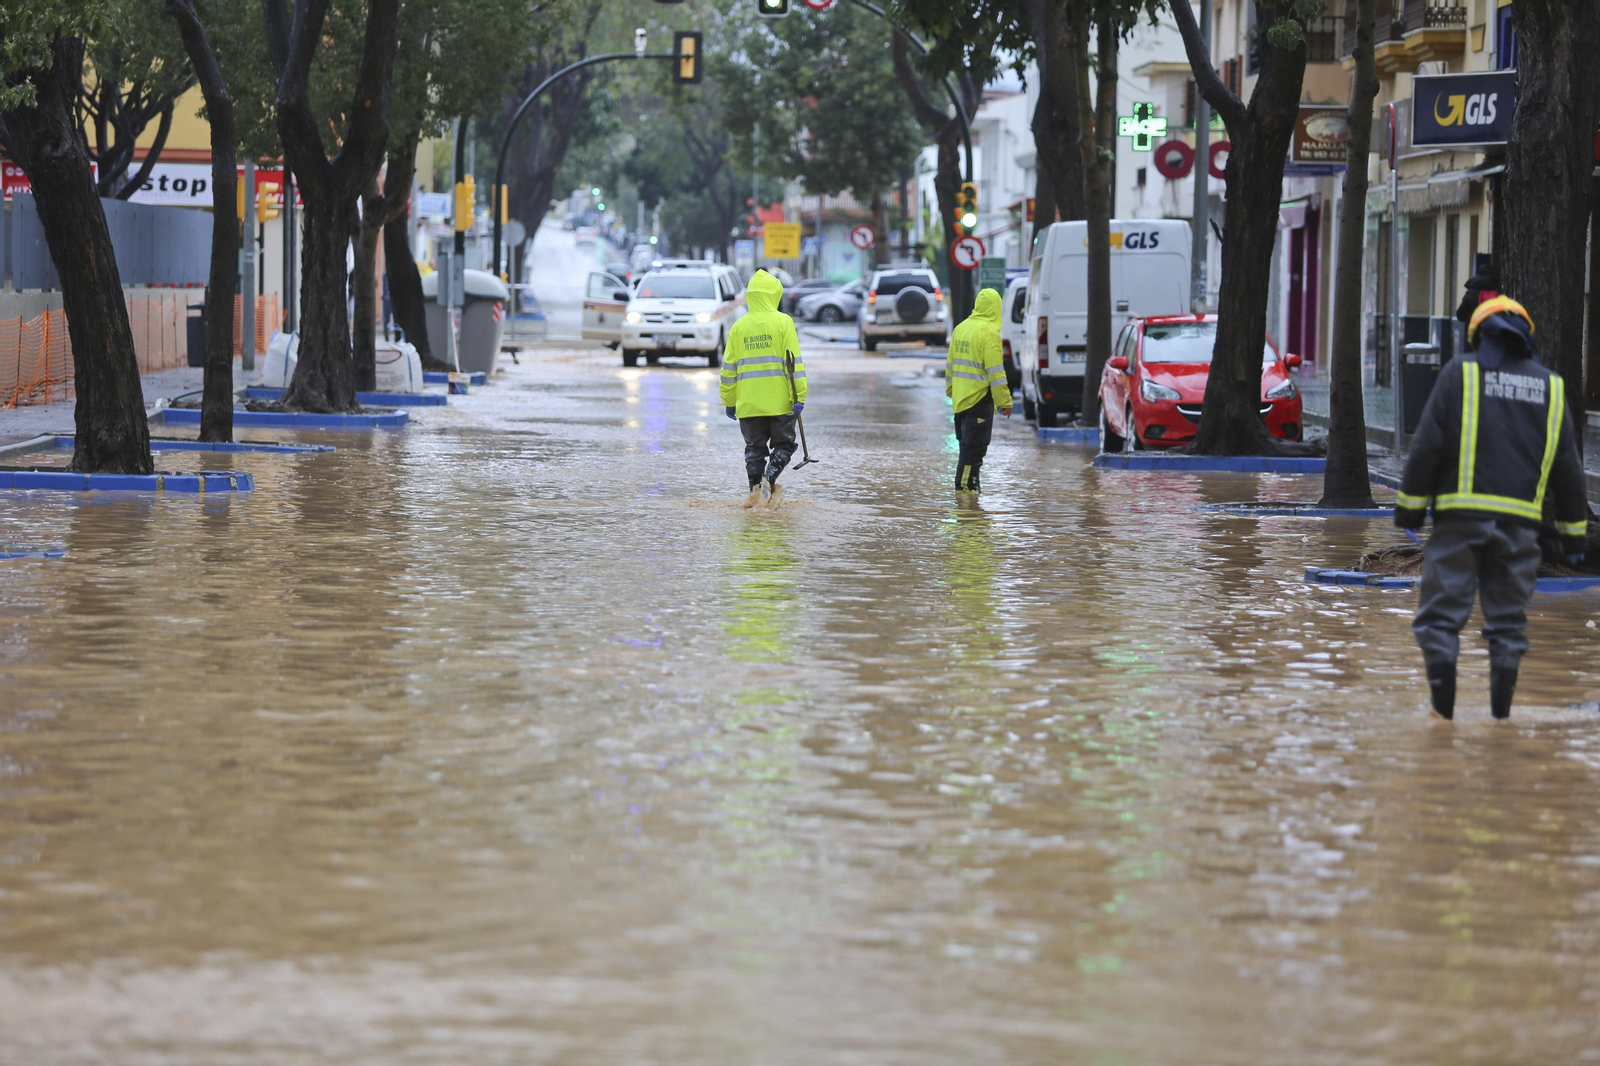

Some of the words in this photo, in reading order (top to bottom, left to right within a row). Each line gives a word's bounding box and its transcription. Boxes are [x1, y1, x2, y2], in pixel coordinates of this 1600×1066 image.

[1465, 92, 1498, 126] GLS
[140, 173, 207, 197] stop
[1125, 231, 1159, 250] GLS
[1498, 371, 1546, 392] BOMBEROS
[1504, 385, 1514, 399] DE
